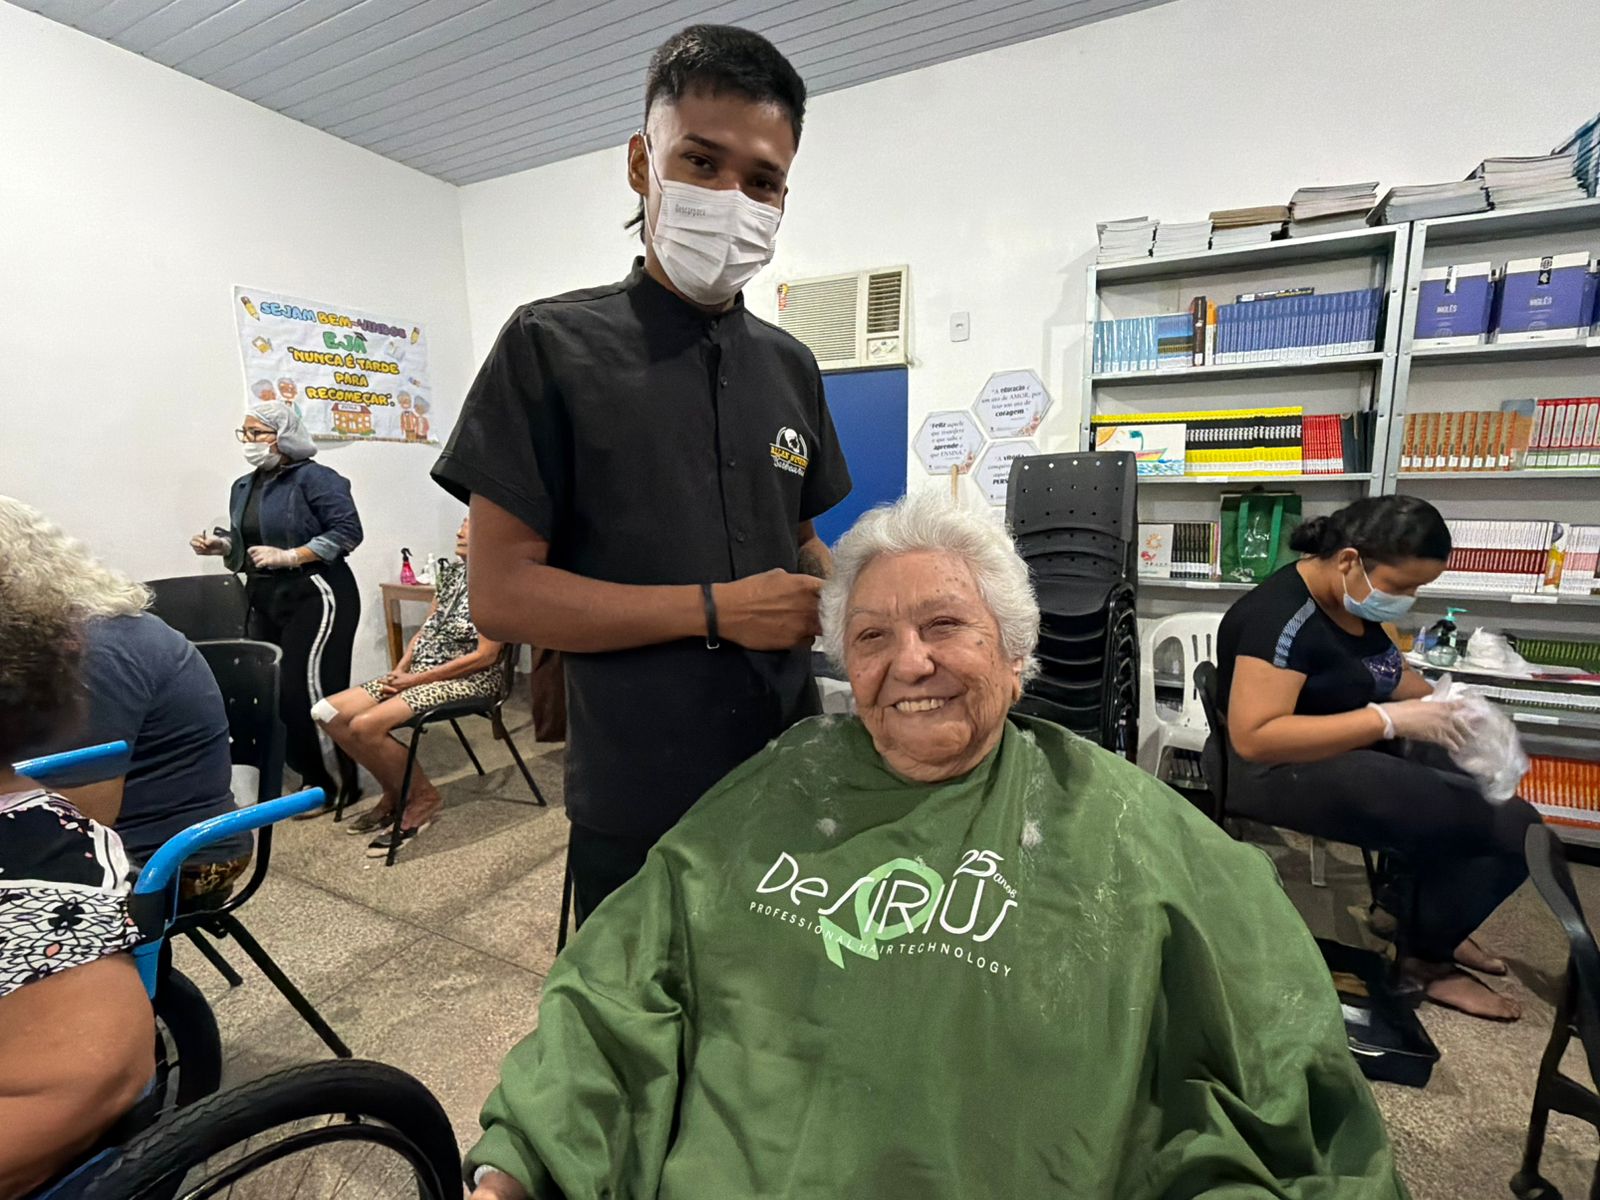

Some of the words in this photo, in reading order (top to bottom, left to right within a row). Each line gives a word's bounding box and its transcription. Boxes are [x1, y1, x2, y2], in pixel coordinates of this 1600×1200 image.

[260, 302, 317, 323] SEJAM
[322, 331, 368, 354] EJA
[344, 354, 356, 369] É
[356, 358, 400, 375] TARDE
[334, 371, 369, 387] PARA
[1000, 385, 1026, 393] educação
[933, 442, 959, 451] aprende
[953, 849, 1004, 877] 25
[993, 873, 1018, 899] anos
[750, 901, 853, 949] PROFESSIONAL
